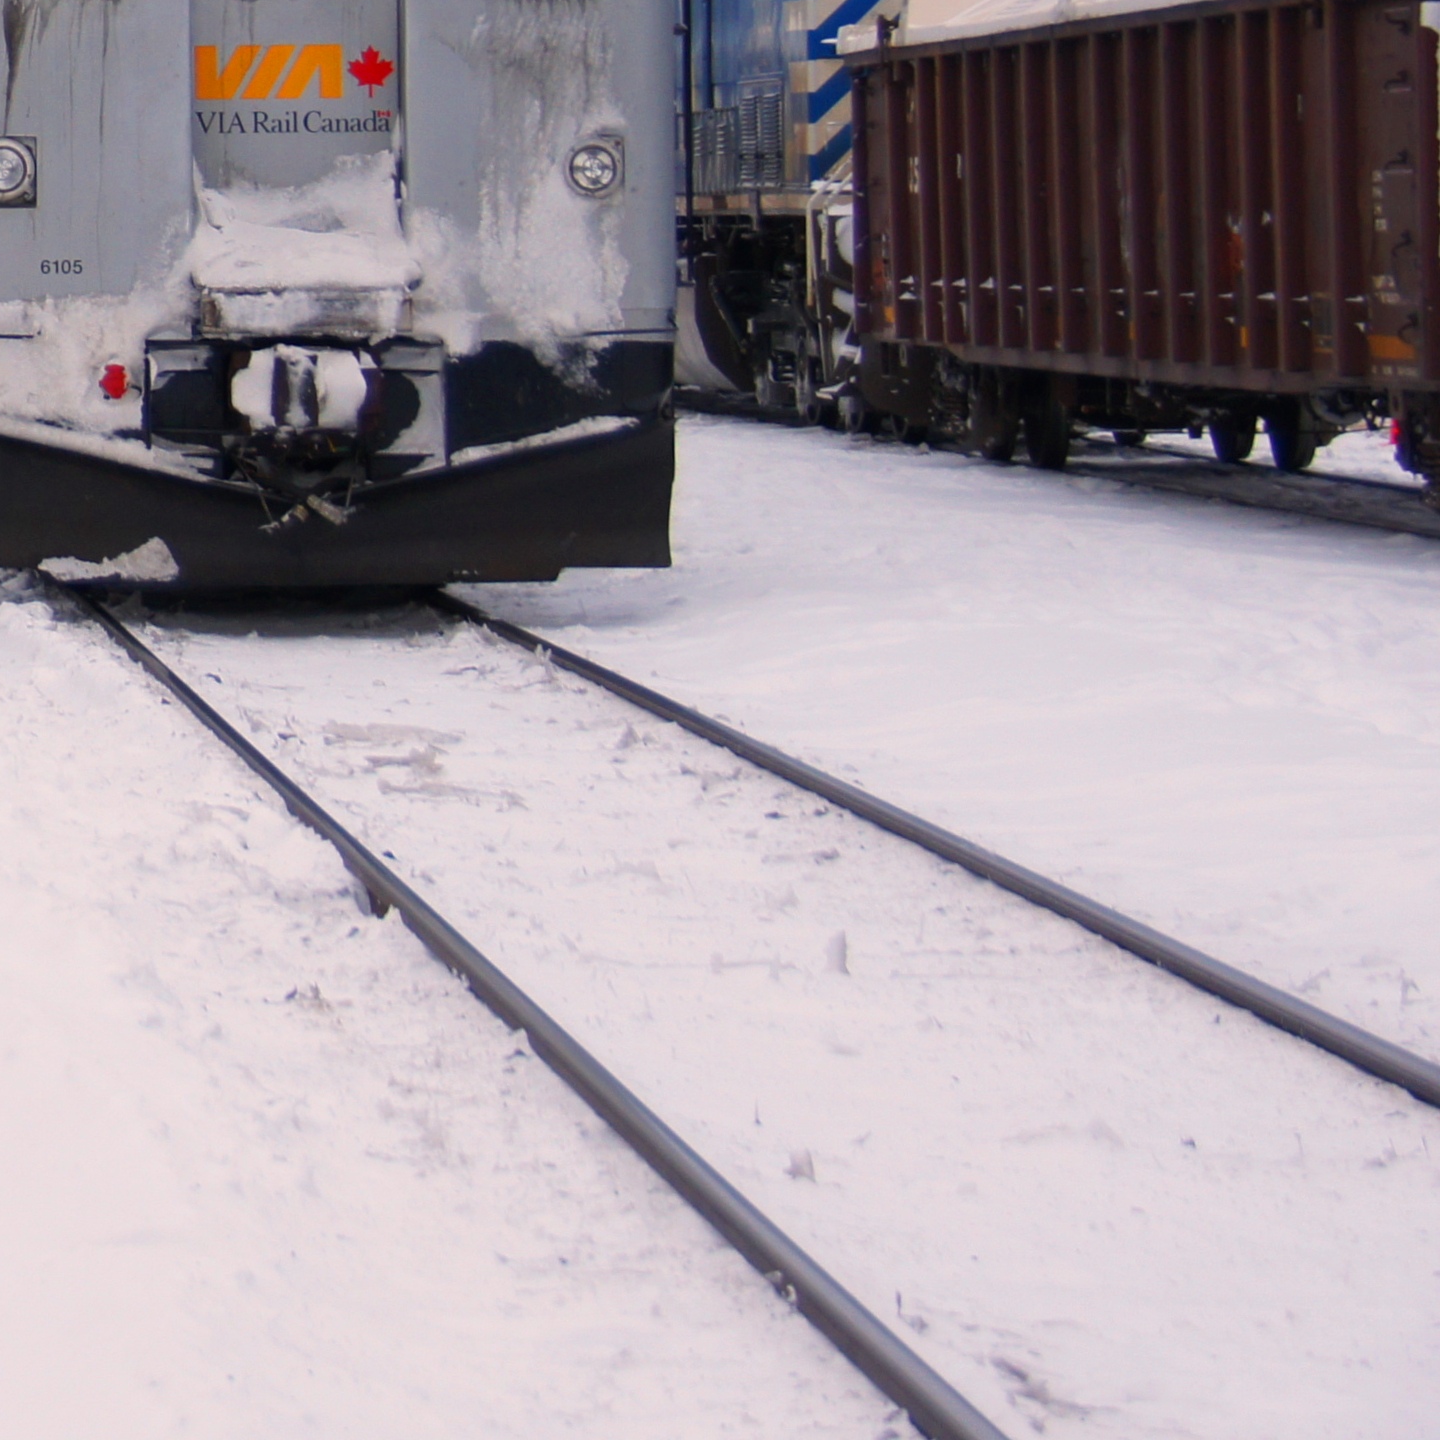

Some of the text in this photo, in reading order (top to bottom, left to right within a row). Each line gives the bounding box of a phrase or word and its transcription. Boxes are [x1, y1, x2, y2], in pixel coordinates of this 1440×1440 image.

[194, 44, 343, 100] VIA
[195, 111, 390, 133] VIA Rail Canada
[41, 259, 83, 274] 6105
